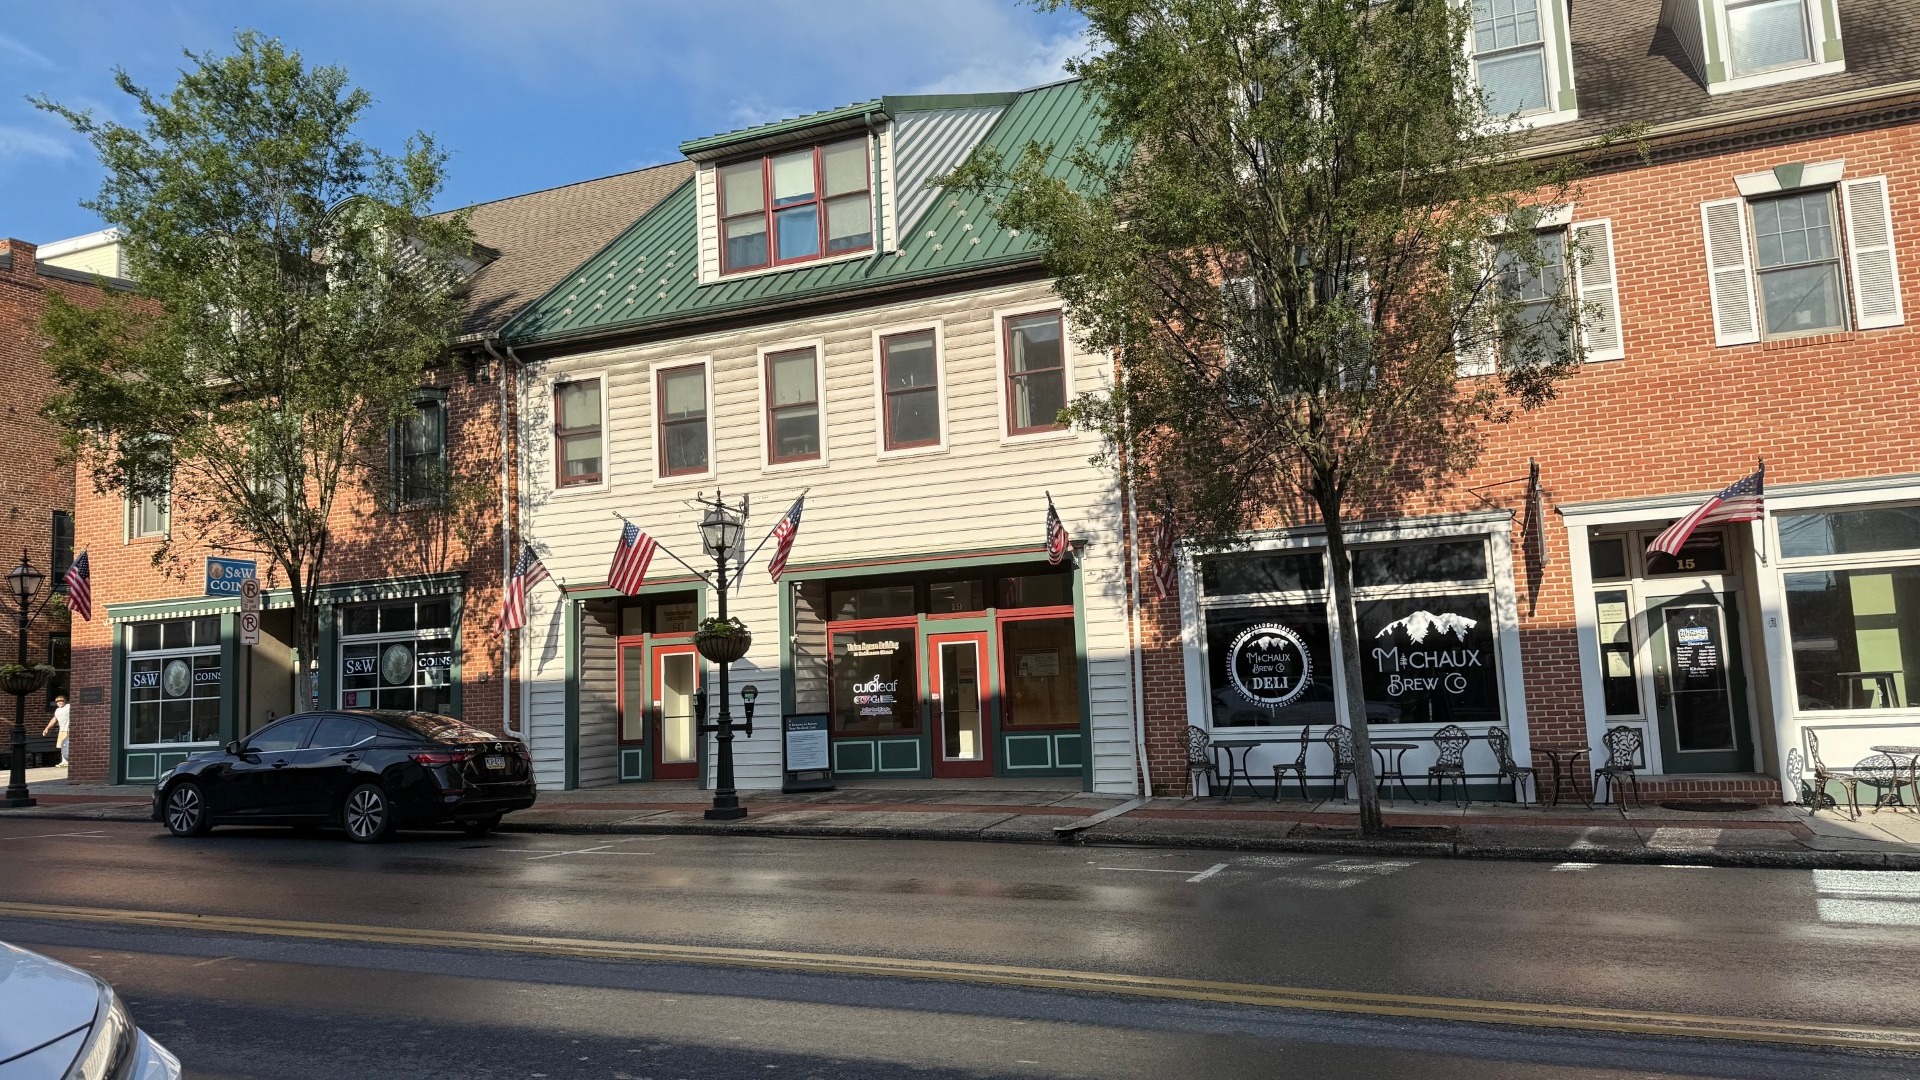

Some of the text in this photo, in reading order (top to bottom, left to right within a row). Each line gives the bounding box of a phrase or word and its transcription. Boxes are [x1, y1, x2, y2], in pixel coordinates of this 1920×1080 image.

[1677, 559, 1696, 570] 15
[225, 566, 255, 579] S&W
[210, 580, 242, 592] COIN
[346, 656, 453, 674] S&W COINS
[133, 673, 159, 687] S&W
[852, 674, 899, 693] curaleaf
[1252, 676, 1289, 690] DELI
[1387, 674, 1439, 697] BREW
